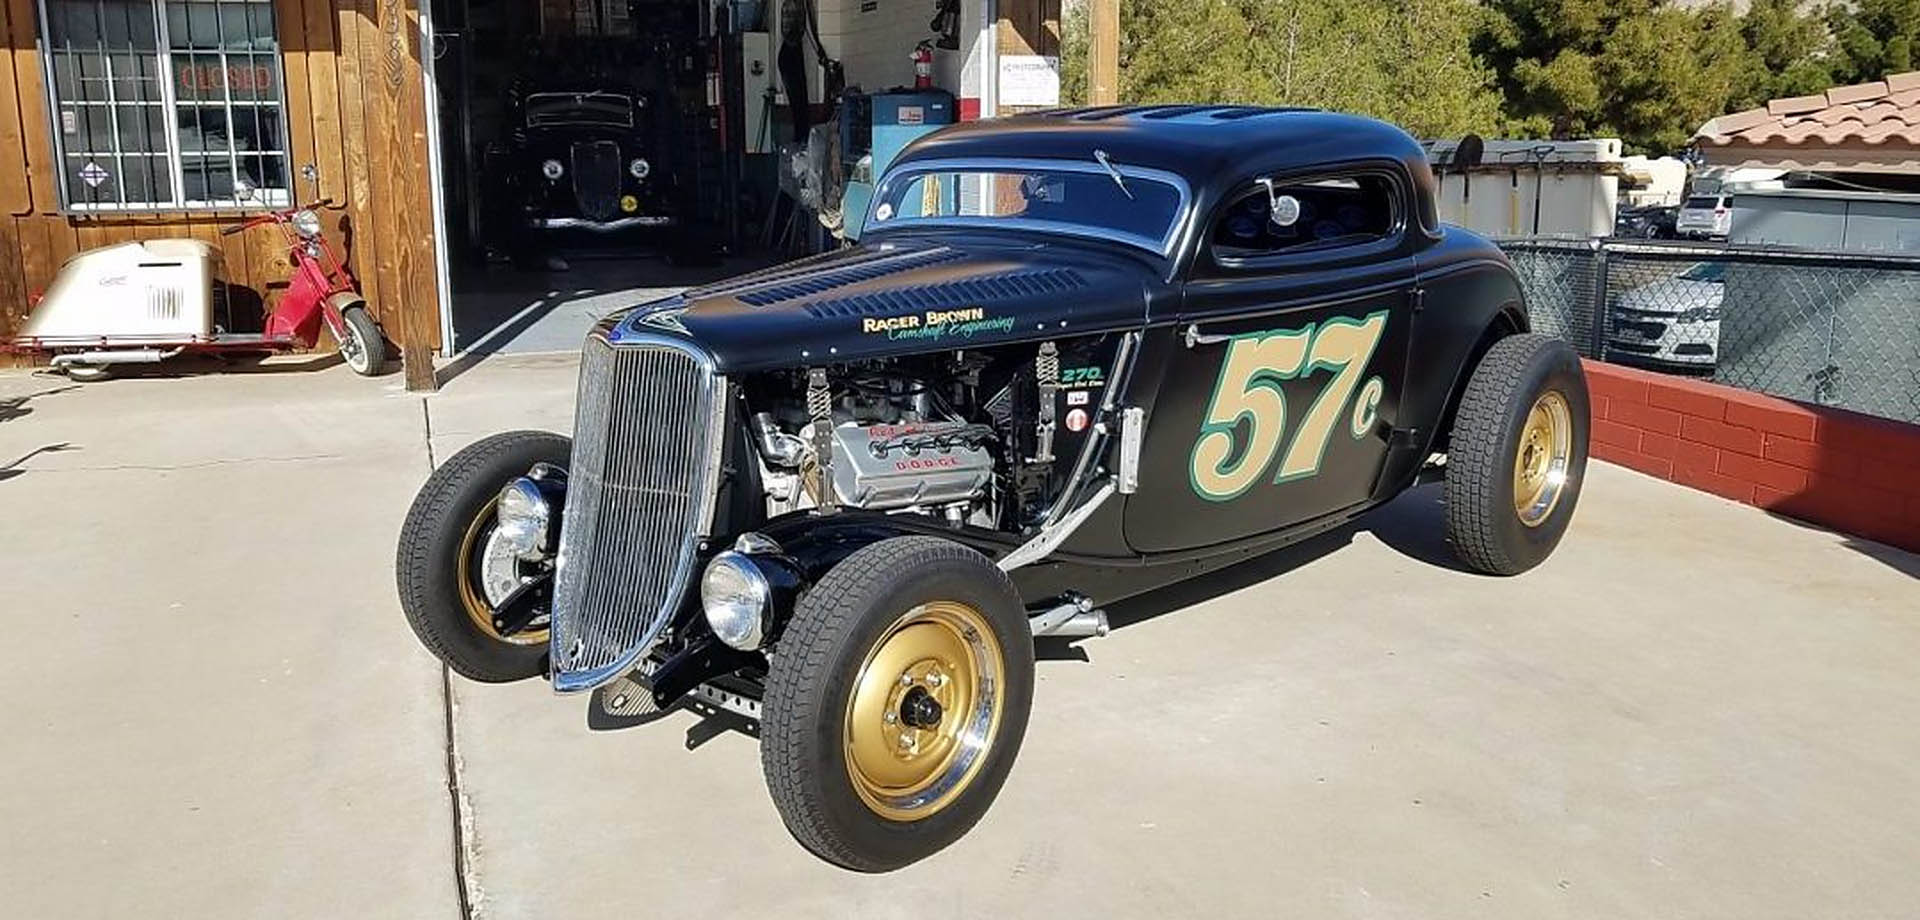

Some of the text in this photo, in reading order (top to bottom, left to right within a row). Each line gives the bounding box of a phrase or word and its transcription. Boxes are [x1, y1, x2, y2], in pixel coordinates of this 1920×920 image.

[182, 65, 271, 91] CLOSED
[925, 307, 984, 325] BROWN
[888, 316, 1015, 341] Camshaft Engineering
[1062, 366, 1101, 382] 270
[895, 456, 961, 471] DODGE
